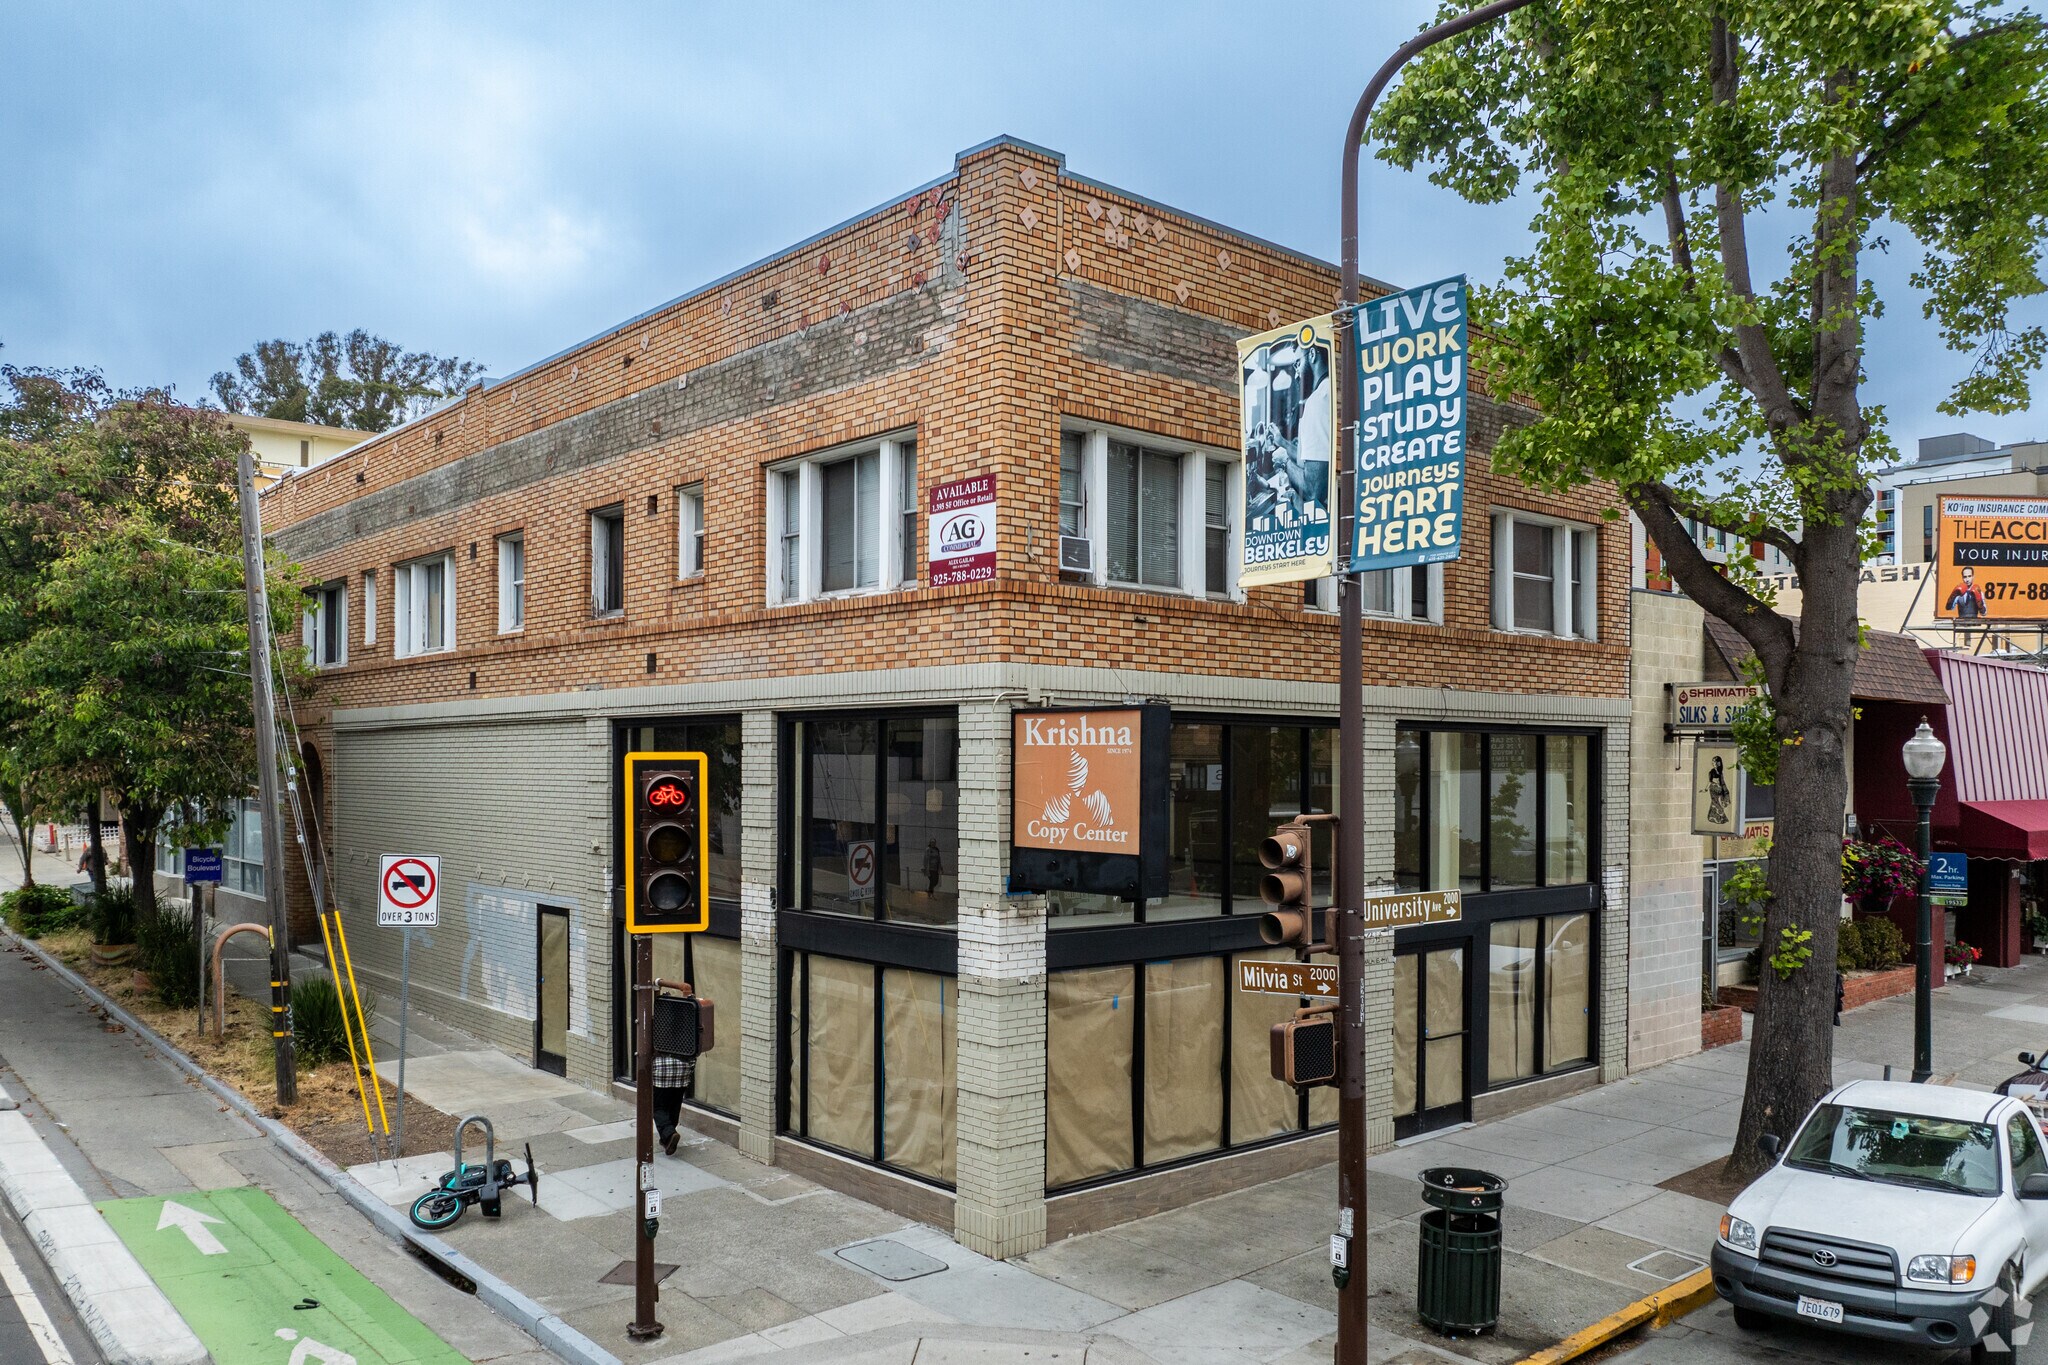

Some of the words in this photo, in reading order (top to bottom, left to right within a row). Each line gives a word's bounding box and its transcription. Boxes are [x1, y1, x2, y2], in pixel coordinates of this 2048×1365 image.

[1358, 282, 1462, 345] LIVE
[1362, 323, 1462, 374] WORK
[1363, 355, 1461, 411] PLAY
[1363, 397, 1461, 442] STUDY
[1360, 430, 1461, 471] CREATE
[1360, 461, 1460, 497] JOURNEYS
[936, 479, 989, 501] AVAILABLE
[953, 498, 969, 508] Office
[976, 492, 993, 503] Retail
[1359, 482, 1460, 524] START
[1947, 502, 1974, 514] KO'ing
[1977, 503, 2025, 514] INSURANCE
[2027, 504, 2048, 514] COM
[948, 519, 976, 542] AG
[1245, 529, 1302, 548] DOWNTOWN
[1357, 512, 1457, 557] HERE
[943, 540, 977, 552] COMMERCIAL
[1244, 535, 1330, 565] BERKELEY
[1959, 548, 1999, 560] YOUR
[933, 566, 992, 586] 925-788-0229
[1243, 563, 1272, 575] JOURNEYS
[1272, 561, 1290, 571] START
[1290, 559, 1306, 567] HERE
[1858, 565, 1921, 584] ASH
[1689, 687, 1757, 698] SHRIMATI'S
[1679, 705, 1707, 723] SILKS
[1712, 705, 1719, 723] &
[1023, 715, 1133, 746] Krishna
[1027, 820, 1069, 844] Copy
[1073, 822, 1128, 843] Center
[192, 855, 216, 864] Bicycle
[1936, 858, 1947, 873] 2
[1948, 865, 1959, 873] hr.
[1364, 896, 1431, 921] University
[1431, 901, 1442, 912] Ave
[1443, 892, 1459, 905] 2000
[381, 911, 403, 922] OVER
[404, 910, 413, 923] 3
[415, 911, 435, 922] TONS
[1243, 965, 1288, 989] Milvia
[1292, 973, 1303, 987] St
[1310, 968, 1336, 982] 2000
[1801, 1300, 1840, 1319] 7E01679
